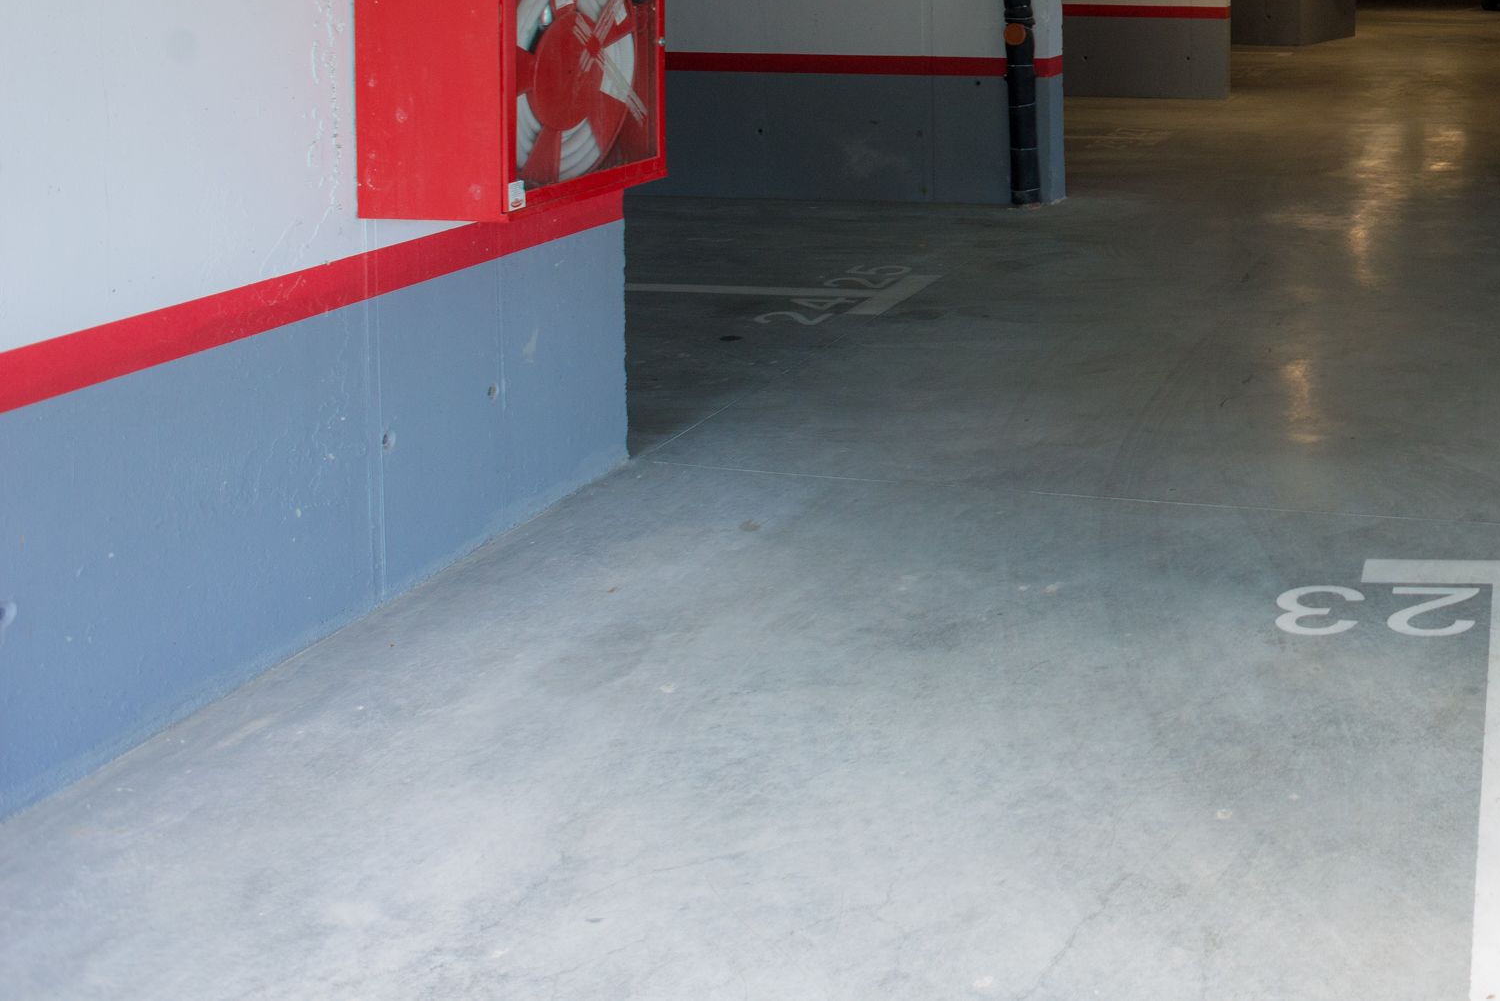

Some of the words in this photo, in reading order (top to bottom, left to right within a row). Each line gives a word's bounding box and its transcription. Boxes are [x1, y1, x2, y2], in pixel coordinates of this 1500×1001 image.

[823, 264, 912, 289] 25
[752, 297, 857, 326] 24
[1274, 585, 1481, 637] 23
